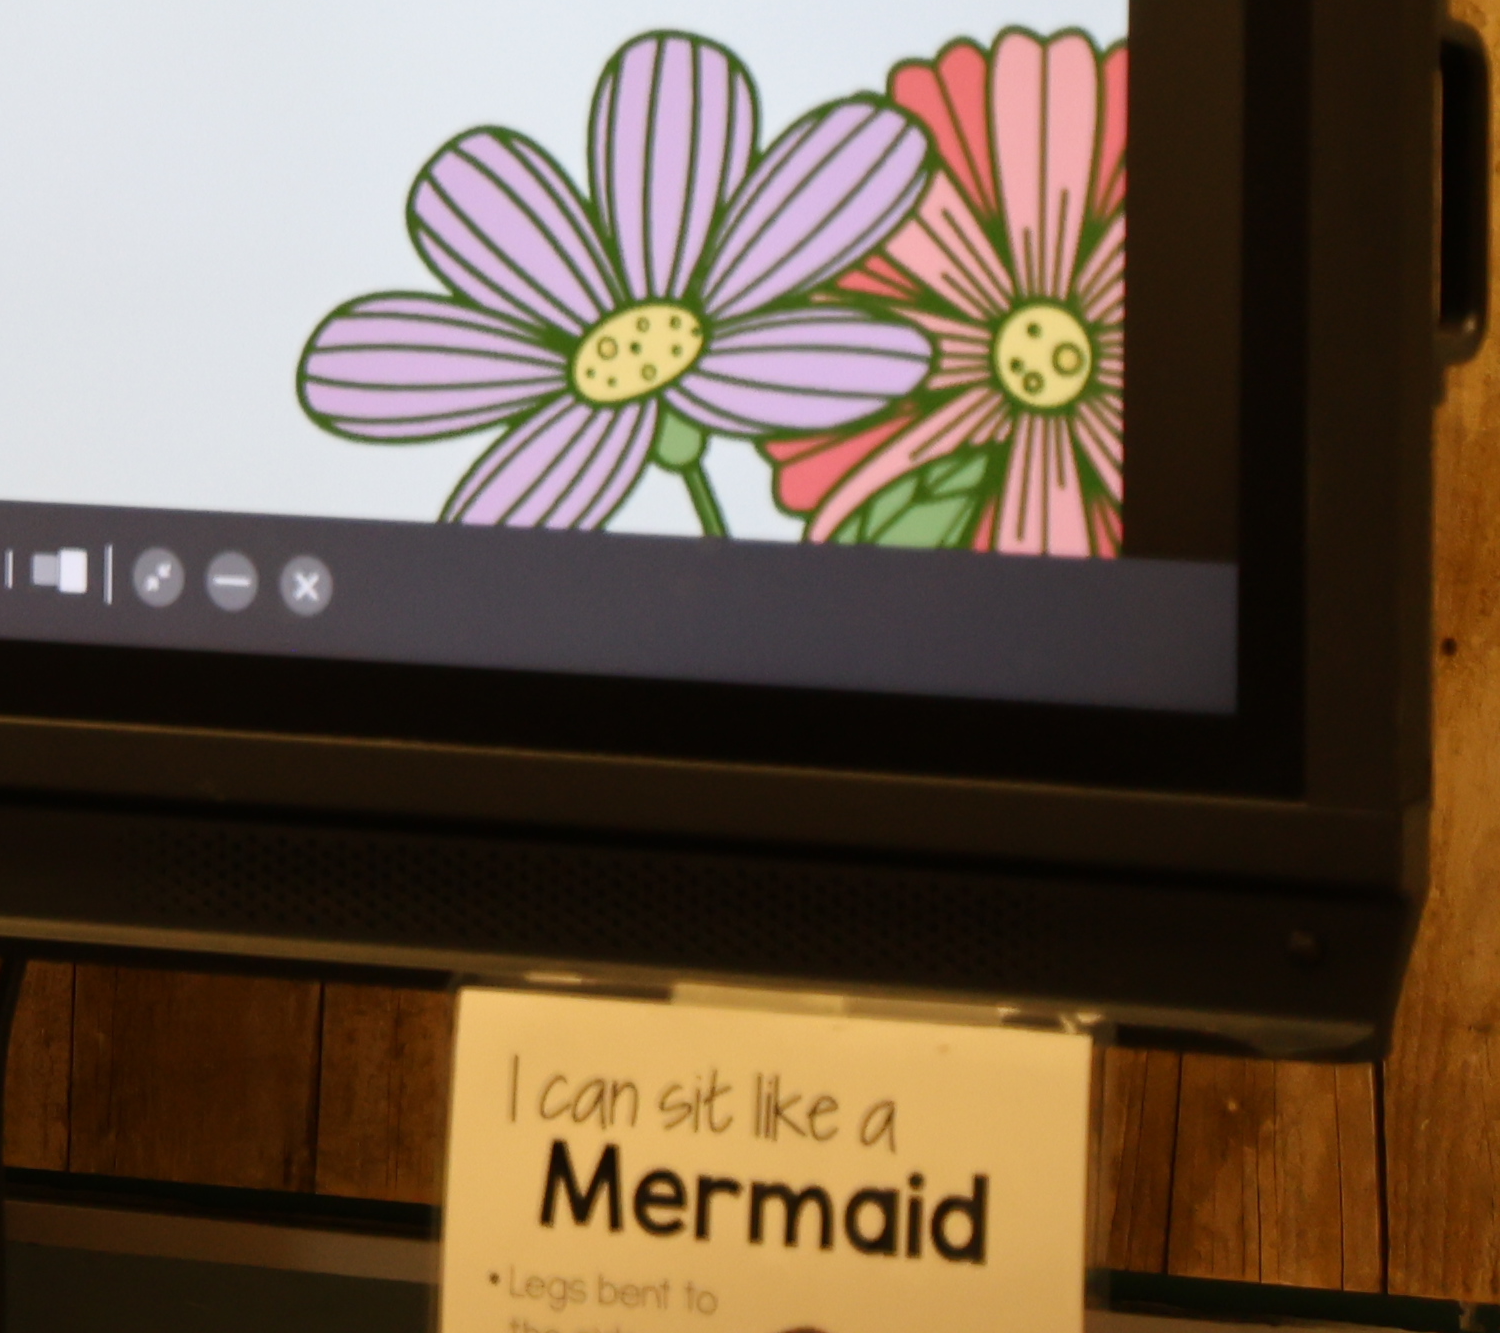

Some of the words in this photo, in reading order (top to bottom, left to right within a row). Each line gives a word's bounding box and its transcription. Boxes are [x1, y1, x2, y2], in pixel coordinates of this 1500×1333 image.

[511, 1055, 519, 1123] I
[539, 1073, 639, 1131] can
[659, 1068, 733, 1133] sit
[755, 1072, 839, 1142] like
[859, 1098, 898, 1154] a
[539, 1139, 990, 1265] Mermaid
[509, 1265, 587, 1312] Legs
[598, 1273, 669, 1310] bent
[686, 1280, 719, 1315] to
